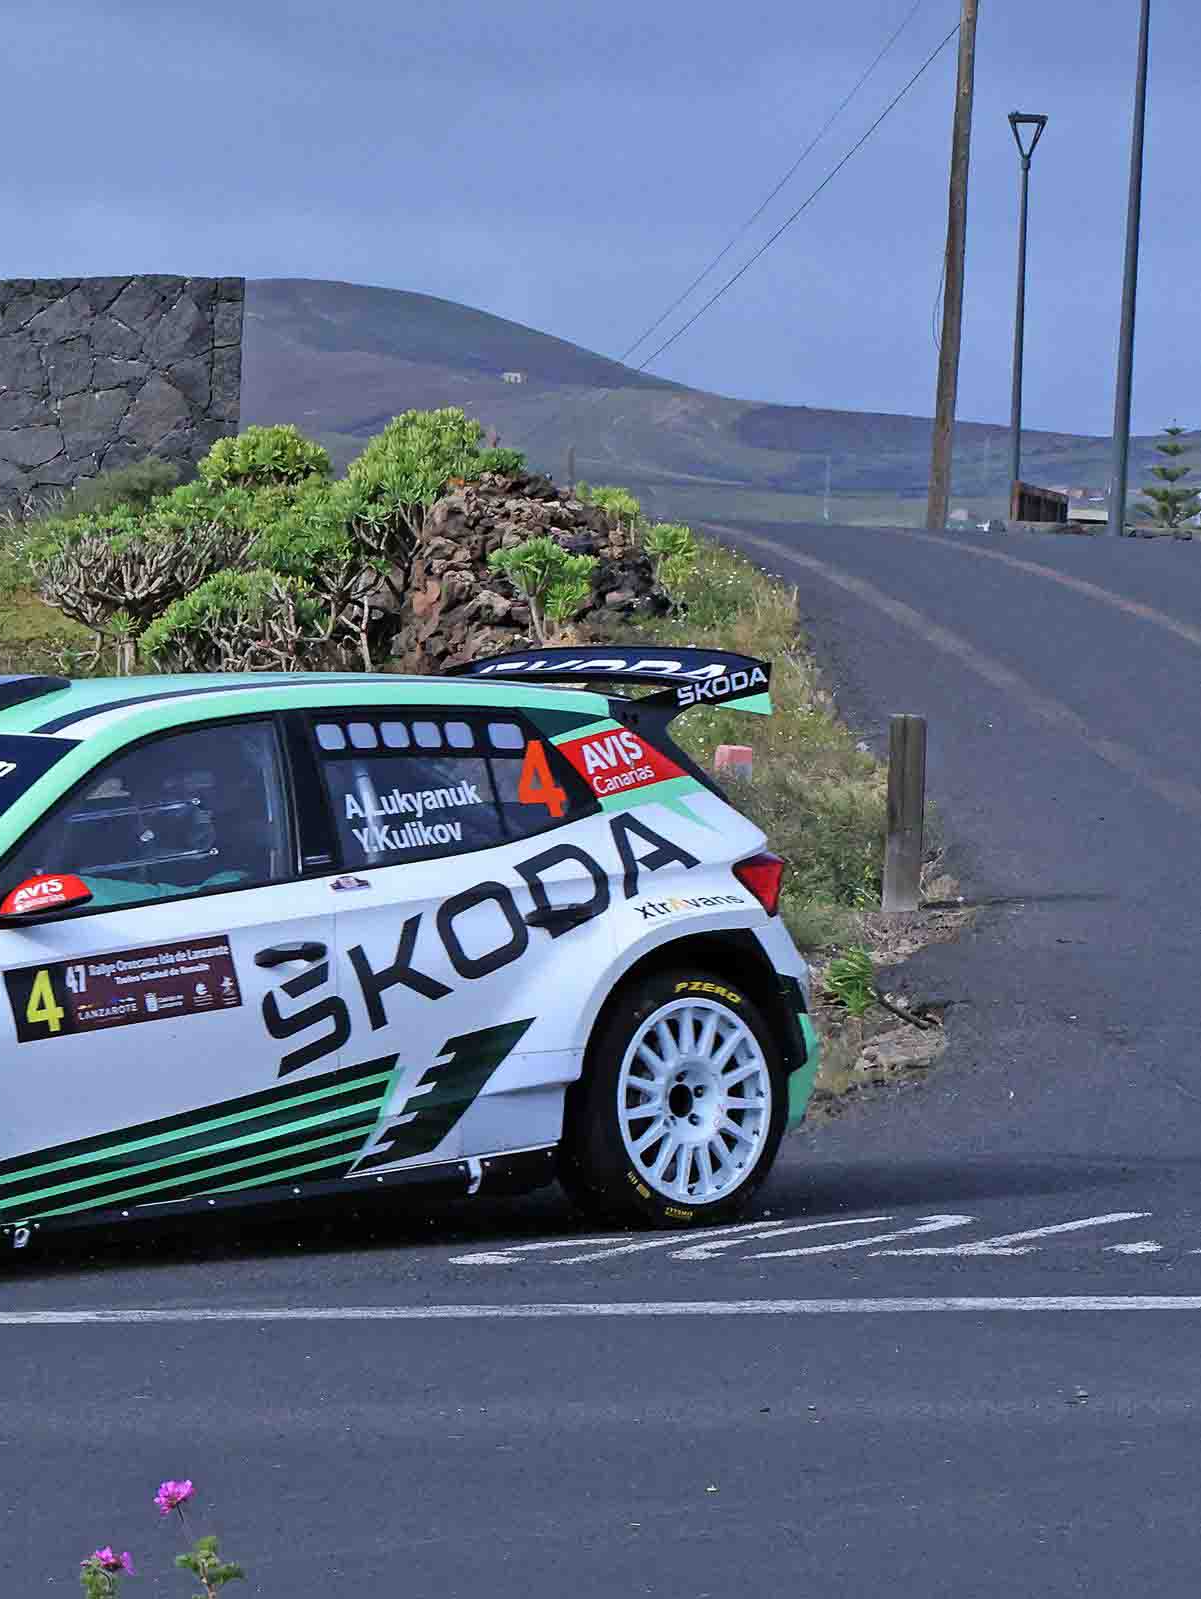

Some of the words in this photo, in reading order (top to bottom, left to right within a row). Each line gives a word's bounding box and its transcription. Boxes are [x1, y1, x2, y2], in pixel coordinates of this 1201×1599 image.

[677, 667, 768, 706] SKODA
[582, 731, 643, 775] AVIS
[517, 740, 567, 818] 4
[592, 764, 656, 795] Canarias
[14, 879, 64, 905] AVIS
[26, 969, 65, 1032] 4
[78, 1003, 139, 1020] LANZAROTE
